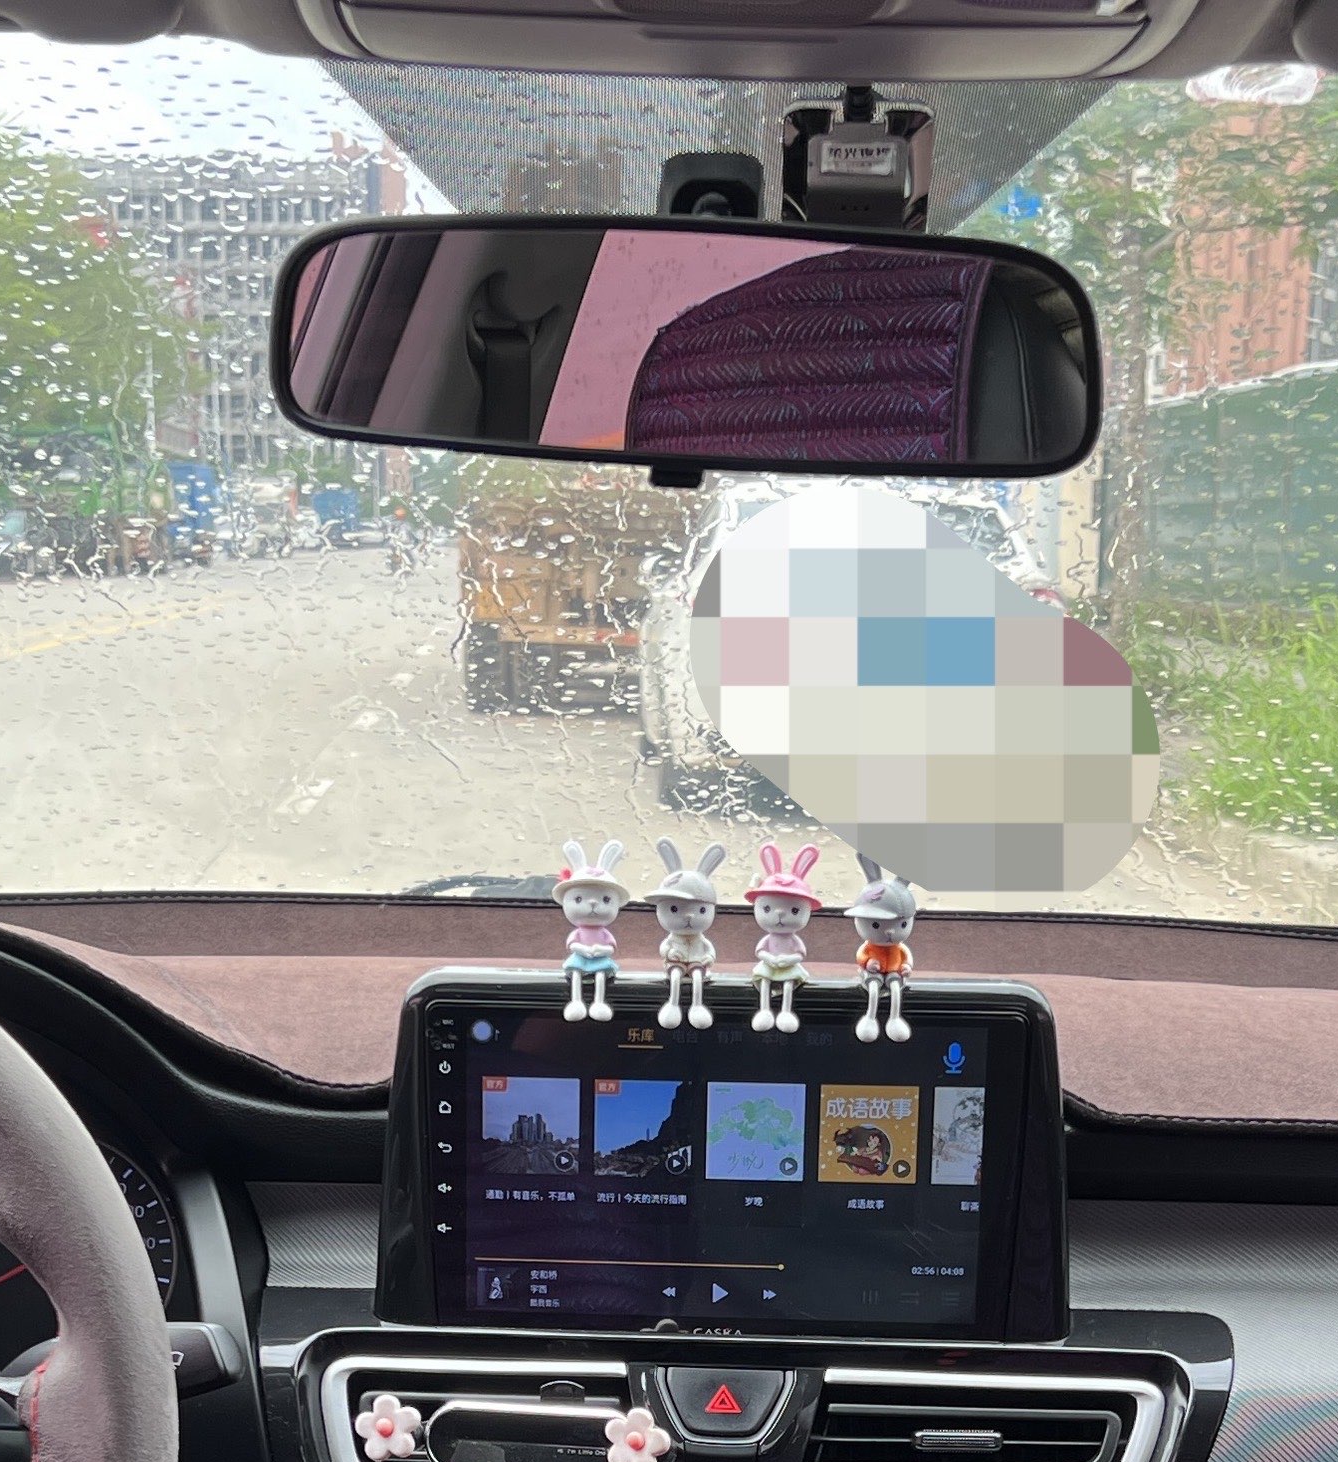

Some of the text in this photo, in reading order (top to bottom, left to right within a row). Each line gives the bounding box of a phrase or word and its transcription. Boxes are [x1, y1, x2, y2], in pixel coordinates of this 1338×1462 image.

[627, 1027, 654, 1043] 乐库
[825, 1097, 913, 1120] 成语故事
[847, 1198, 885, 1211] 成语故事
[911, 1265, 936, 1276] 02:56
